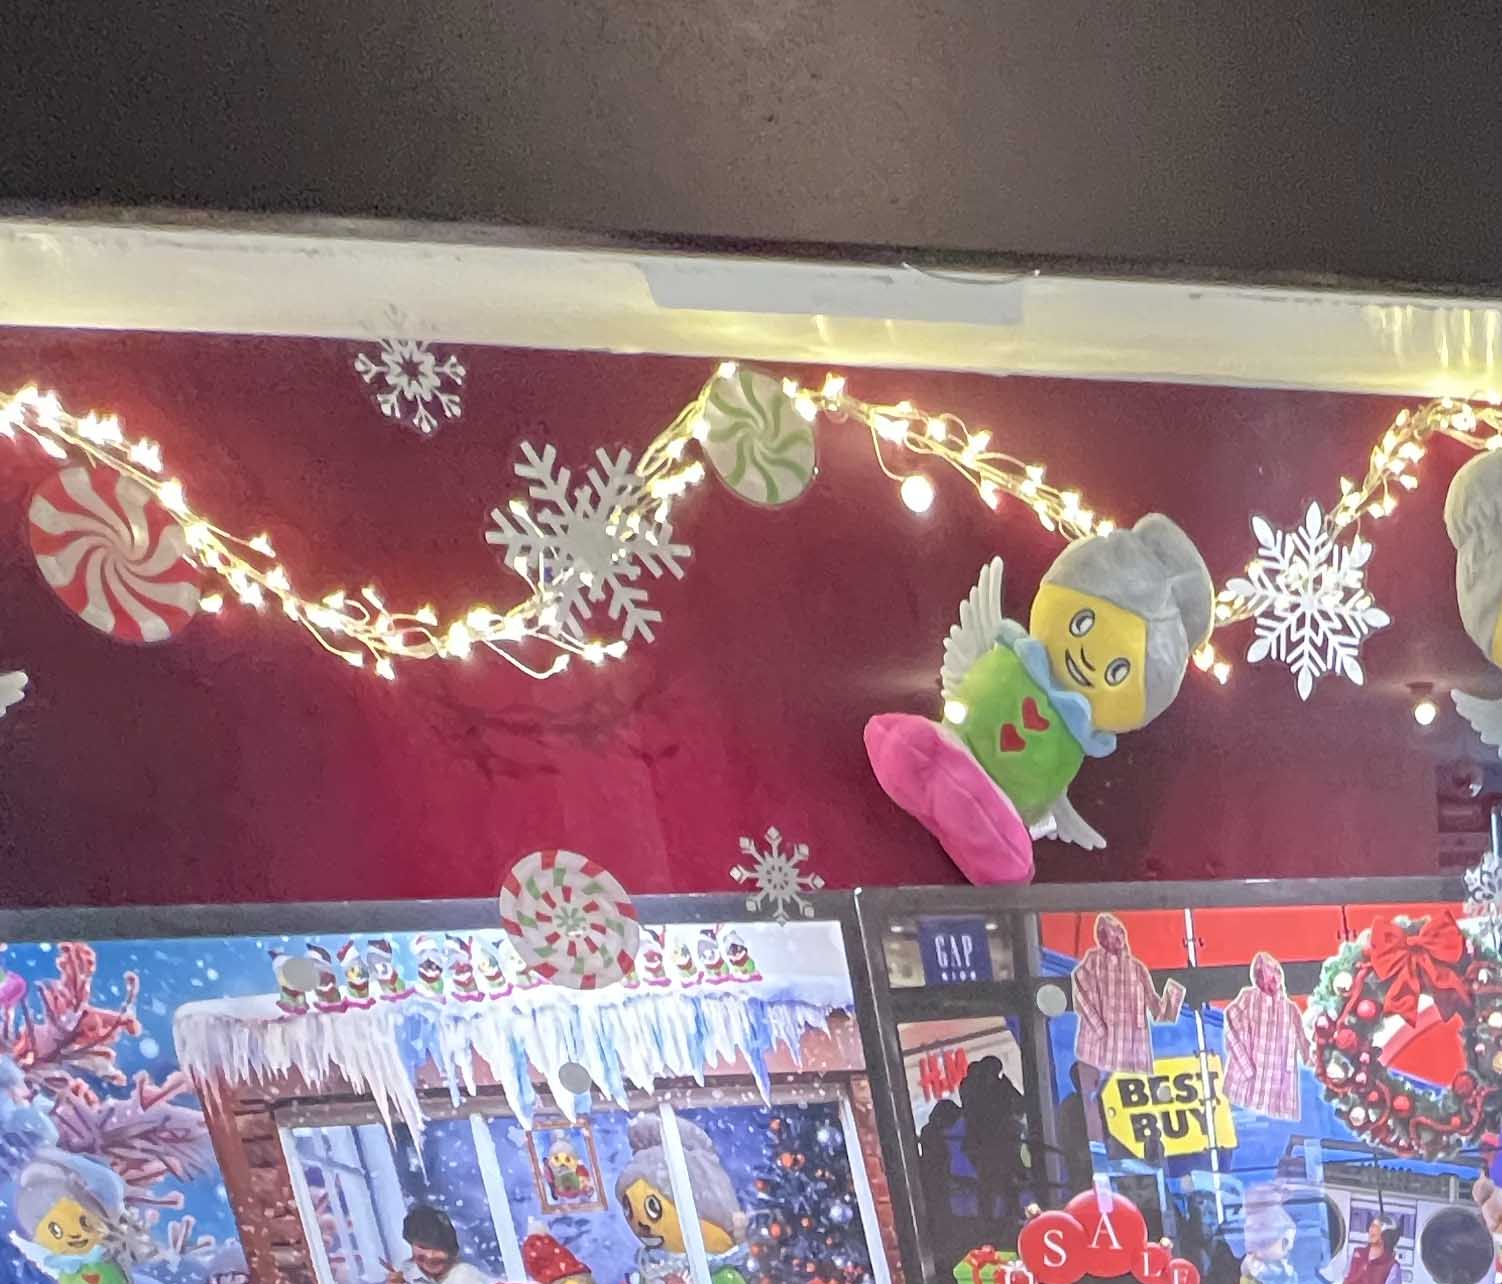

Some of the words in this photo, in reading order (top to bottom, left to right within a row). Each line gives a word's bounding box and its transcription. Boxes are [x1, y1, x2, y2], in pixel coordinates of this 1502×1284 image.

[934, 935, 973, 968] GAP
[1117, 1071, 1219, 1109] BEST
[1129, 1107, 1216, 1143] BUY
